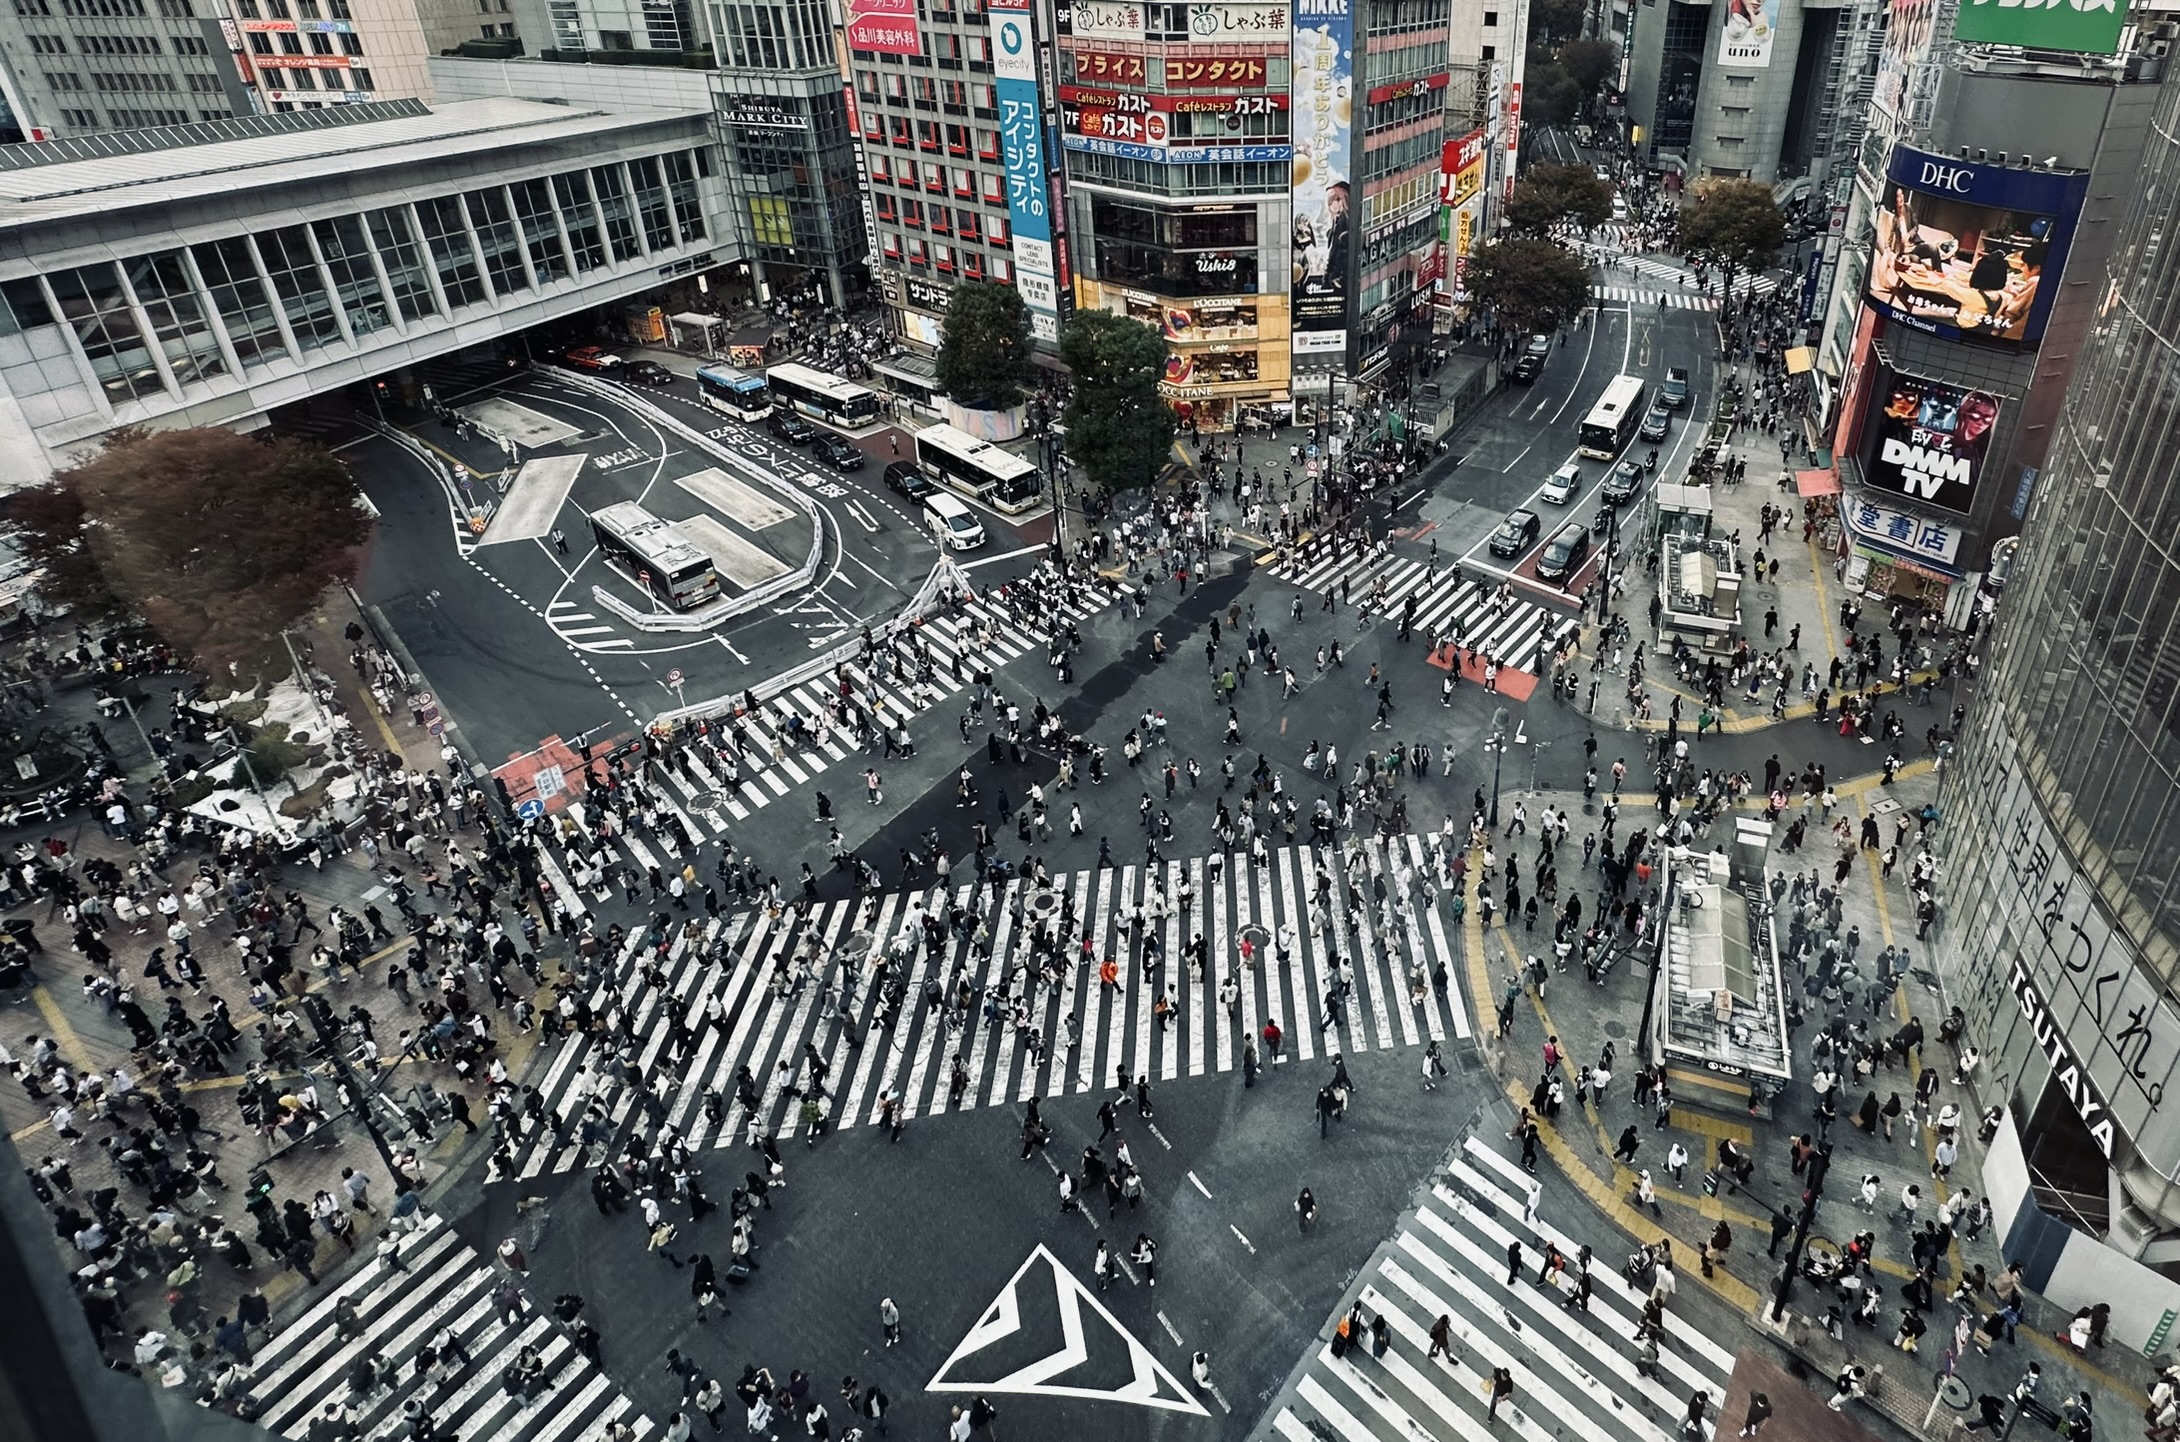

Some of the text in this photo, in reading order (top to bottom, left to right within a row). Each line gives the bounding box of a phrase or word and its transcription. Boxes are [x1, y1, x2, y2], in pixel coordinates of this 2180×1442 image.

[1057, 9, 1070, 22] 9F
[1096, 7, 1139, 29] しゃぶ葉
[1223, 8, 1285, 30] しゃぶ葉
[858, 26, 914, 48] 品川美容外科
[1728, 47, 1761, 57] uno
[998, 58, 1030, 72] eyecity
[1076, 54, 1144, 78] プライス
[1166, 60, 1263, 81] コンタクト
[741, 104, 782, 113] SHIBUYA
[1117, 93, 1151, 114] ガスト
[1234, 97, 1279, 114] ガスト
[1314, 23, 1332, 186] 1周年ありがとう
[723, 111, 807, 125] MARK CITY
[1064, 111, 1080, 125] 7F
[1102, 113, 1143, 138] ガスト
[1002, 99, 1029, 214] アイシティ
[1021, 101, 1044, 217] コンタクトの
[1089, 140, 1149, 157] 英会話イーオン
[1173, 150, 1202, 161] AEON
[1208, 147, 1290, 161] 英会話イーオン
[1920, 162, 1975, 193] DHC
[1021, 242, 1043, 253] CONTACT
[1018, 255, 1049, 268] SPECIALISTS
[1195, 259, 1237, 272] Ushi8
[1193, 297, 1242, 309] L'OCCITANE
[1411, 286, 1431, 310] LUSH
[1891, 310, 1937, 333] DHC Channel
[1881, 437, 1972, 485] DMM
[1900, 467, 1945, 500] TV
[1849, 500, 1944, 552] 堂書店
[2012, 960, 2114, 1160] TSUTAYA
